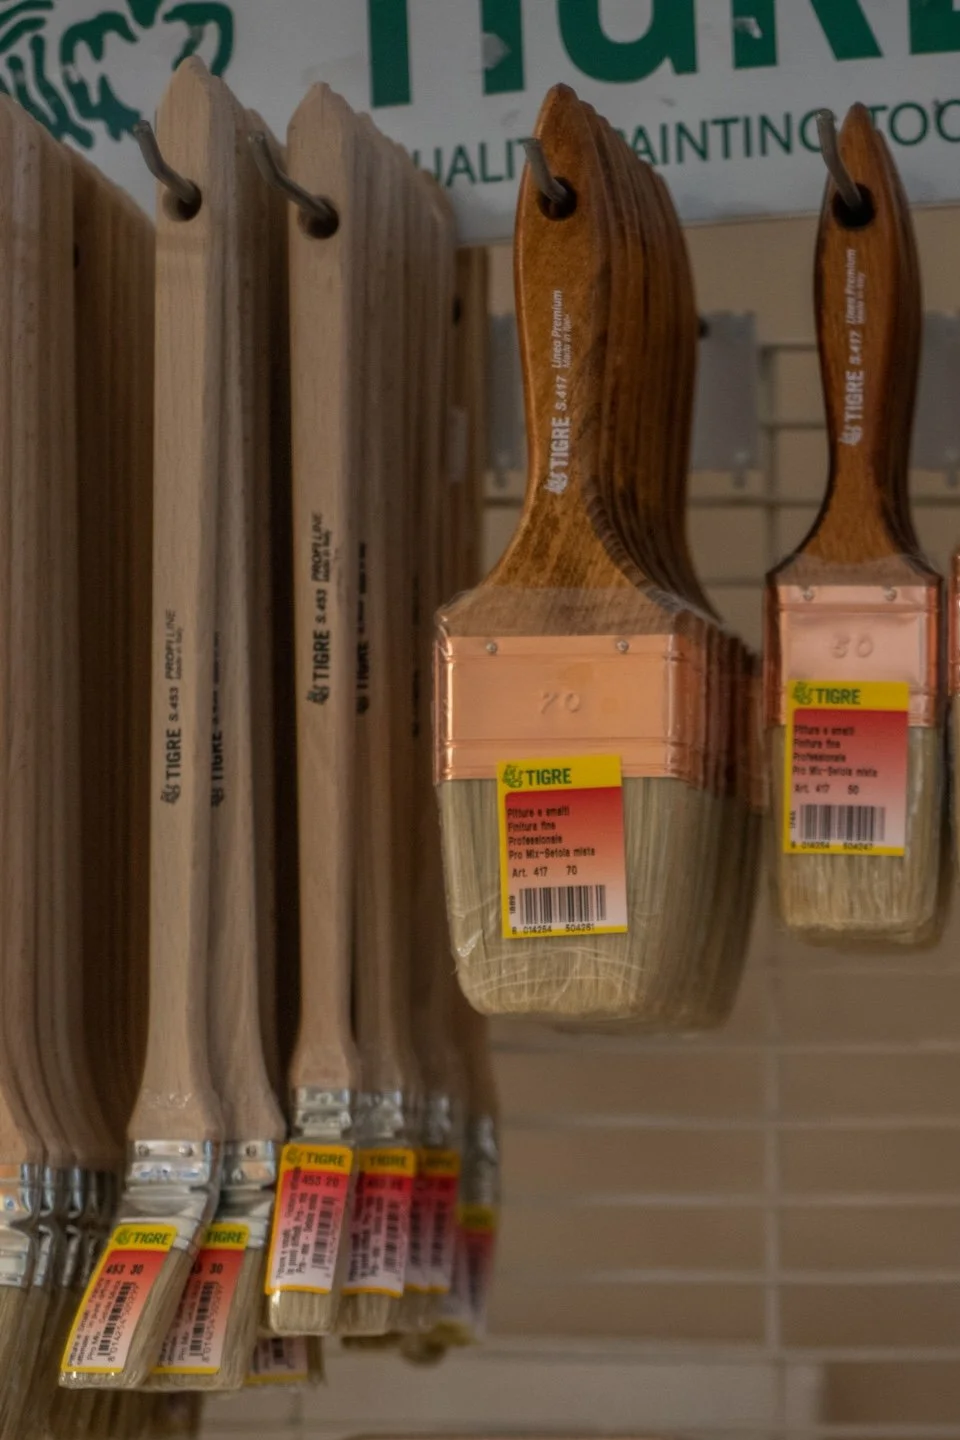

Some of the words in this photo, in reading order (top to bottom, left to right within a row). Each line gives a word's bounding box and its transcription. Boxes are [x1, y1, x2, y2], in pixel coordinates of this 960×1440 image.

[844, 369, 865, 421] TIGRE
[550, 416, 571, 470] TIGRE
[312, 629, 331, 680] TIGRE
[815, 687, 862, 706] TIGRE
[165, 728, 182, 776] TIGRE
[525, 768, 573, 787] TIGRE
[512, 867, 528, 879] Art.
[533, 866, 549, 878] 417
[566, 865, 578, 876] 70
[306, 1151, 345, 1166] TIGRE
[325, 1175, 339, 1187] 20
[133, 1231, 171, 1246] TIGRE
[130, 1263, 144, 1275] 30
[209, 1262, 223, 1275] 30
